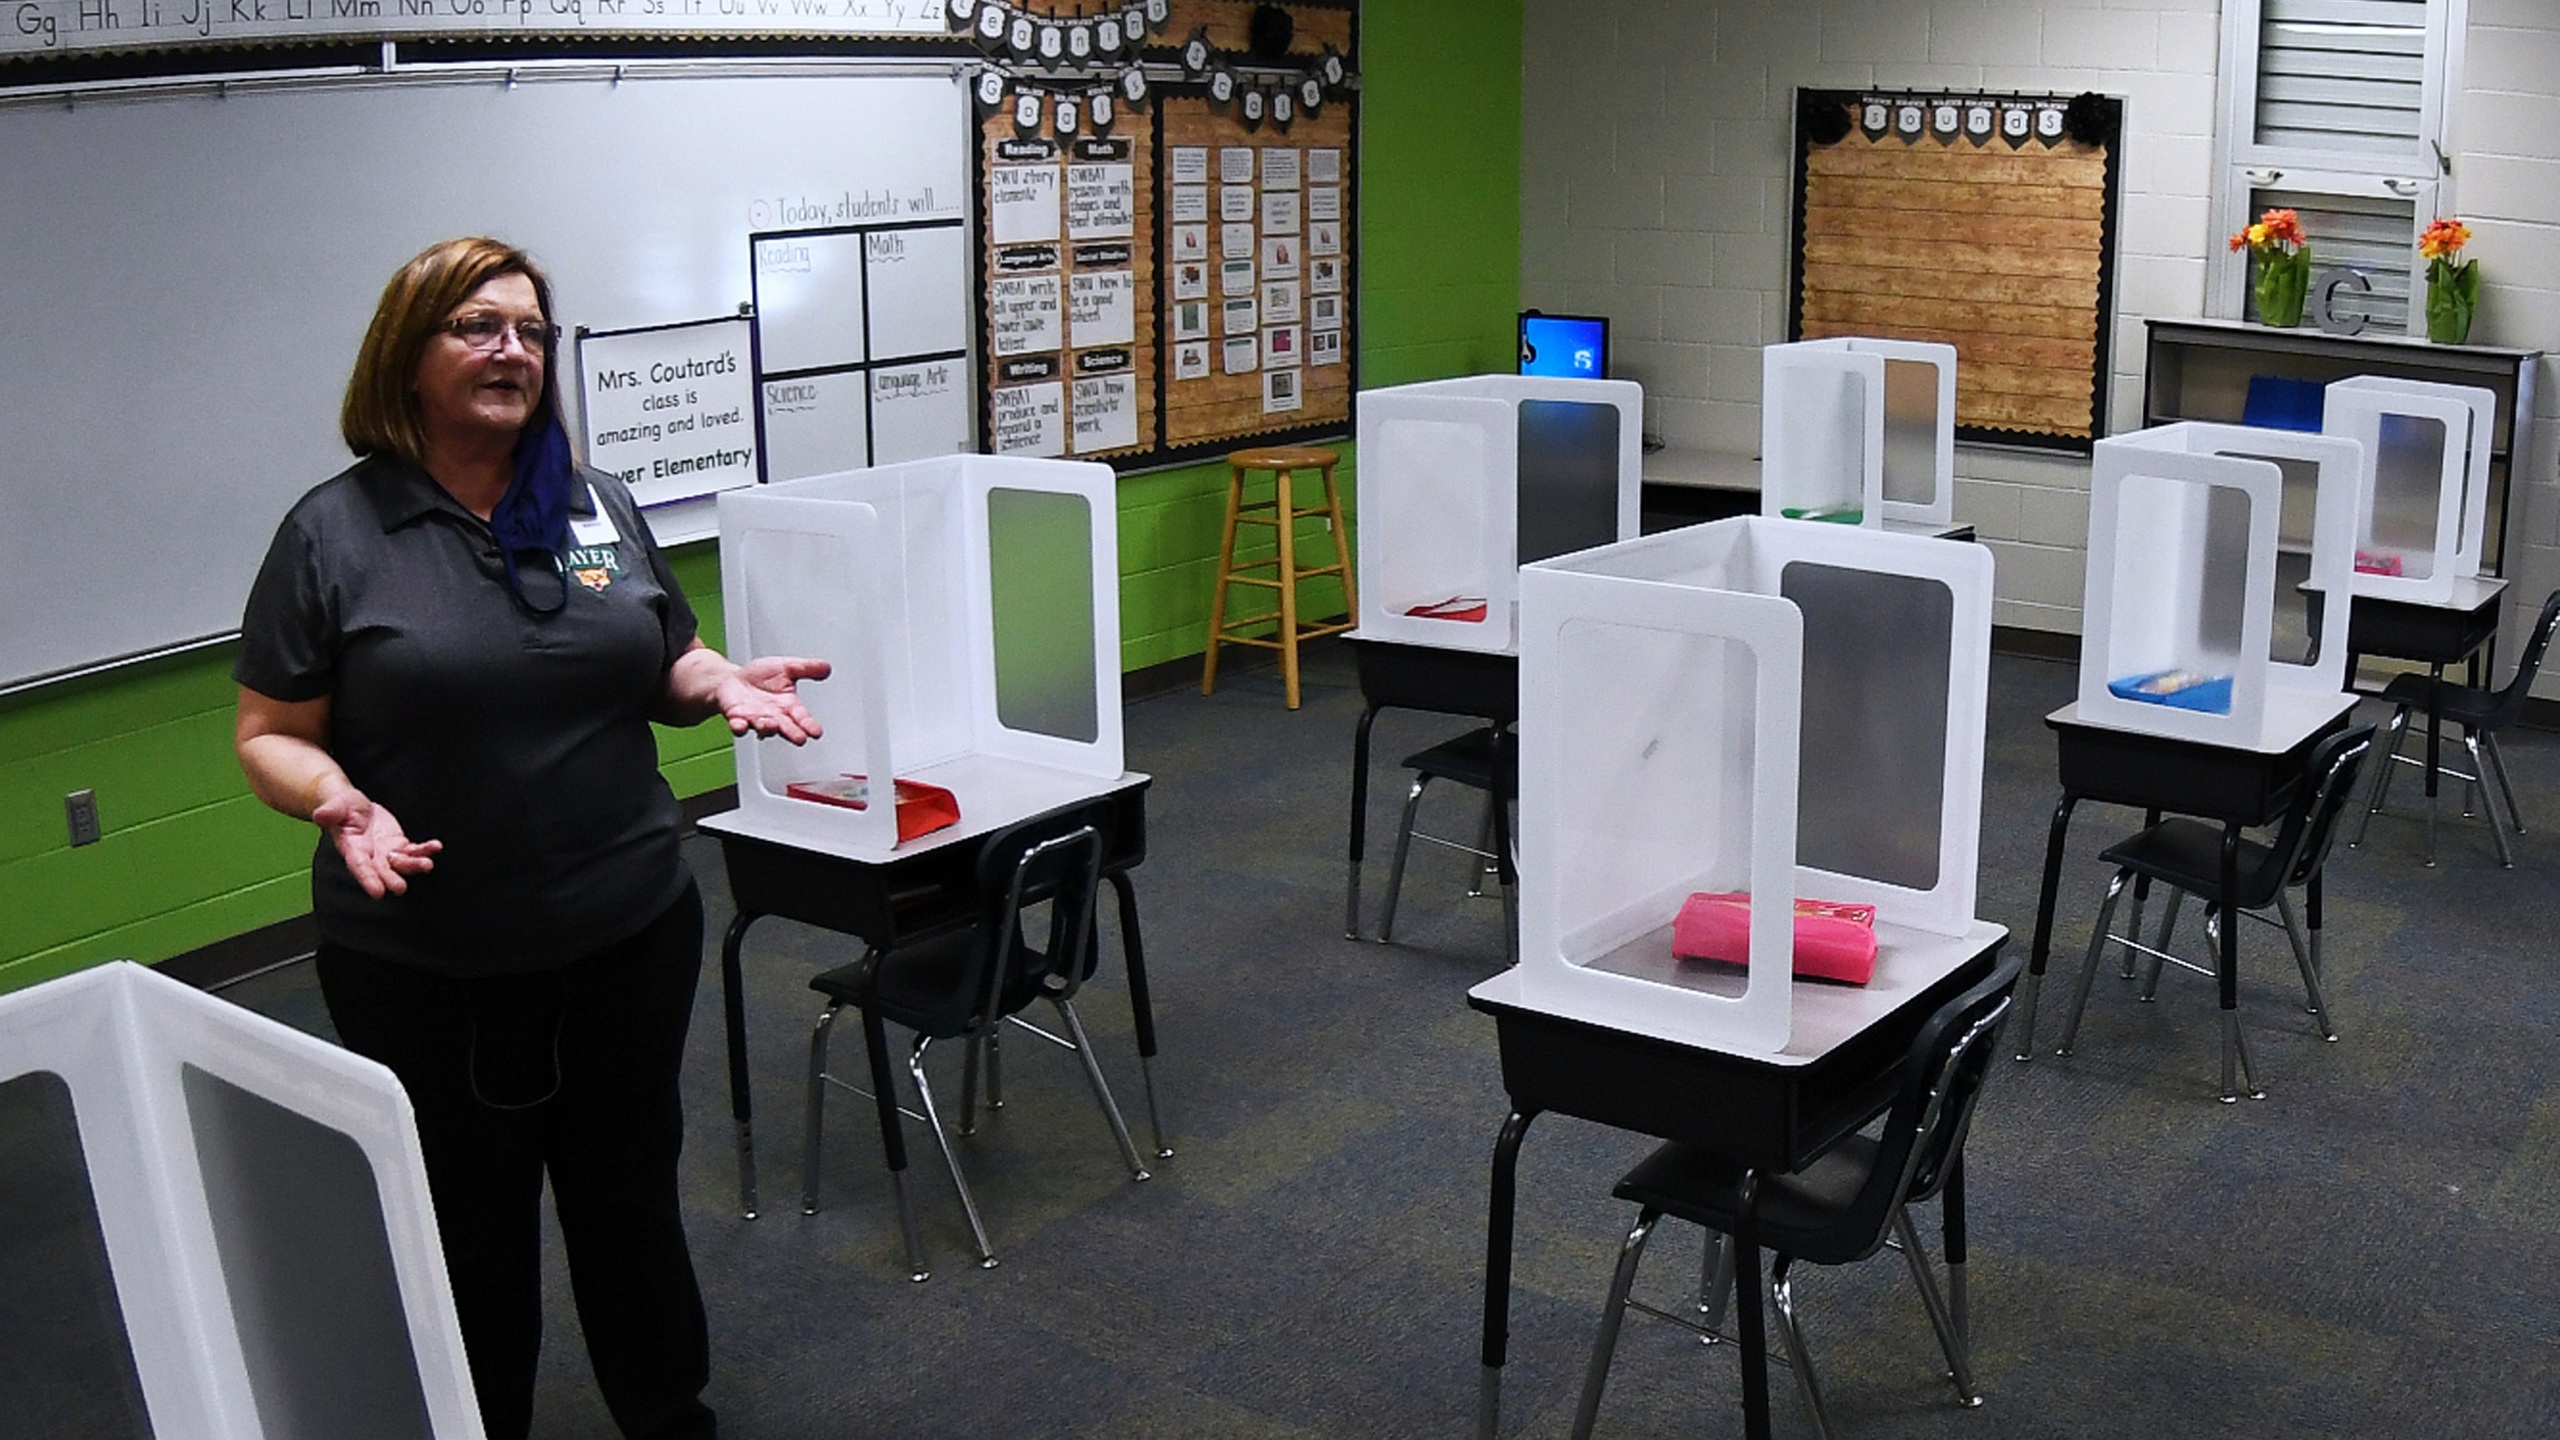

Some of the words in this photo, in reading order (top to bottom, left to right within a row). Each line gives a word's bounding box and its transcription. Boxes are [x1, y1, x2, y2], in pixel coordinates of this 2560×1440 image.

[16, 3, 56, 46] Gg
[79, 0, 119, 30] Hh
[181, 0, 210, 36] Jj
[230, 0, 266, 21] Kk
[331, 0, 381, 17] Mm
[399, 0, 433, 16] Nn
[450, 0, 485, 14] Oo
[920, 0, 940, 19] Zz
[1004, 143, 1049, 157] Reading
[1088, 143, 1114, 154] Math
[1022, 170, 1055, 190] story
[778, 197, 832, 225] Today,
[836, 189, 899, 219] students
[868, 233, 905, 256] Math
[1099, 275, 1119, 290] how
[1039, 298, 1057, 311] and
[2312, 268, 2371, 337] C
[1009, 363, 1048, 376] Writing
[1084, 354, 1124, 367] Science
[597, 370, 642, 392] Mrs.
[650, 350, 736, 384] Coutard's
[765, 384, 816, 405] Science
[870, 371, 922, 399] Language
[1104, 380, 1124, 394] how
[642, 394, 680, 411] class
[685, 389, 698, 404] is
[1040, 399, 1058, 415] and
[596, 422, 662, 446] amazing
[667, 413, 695, 434] and
[701, 406, 744, 429] loved.
[1034, 420, 1042, 430] a
[652, 448, 752, 479] Elementary
